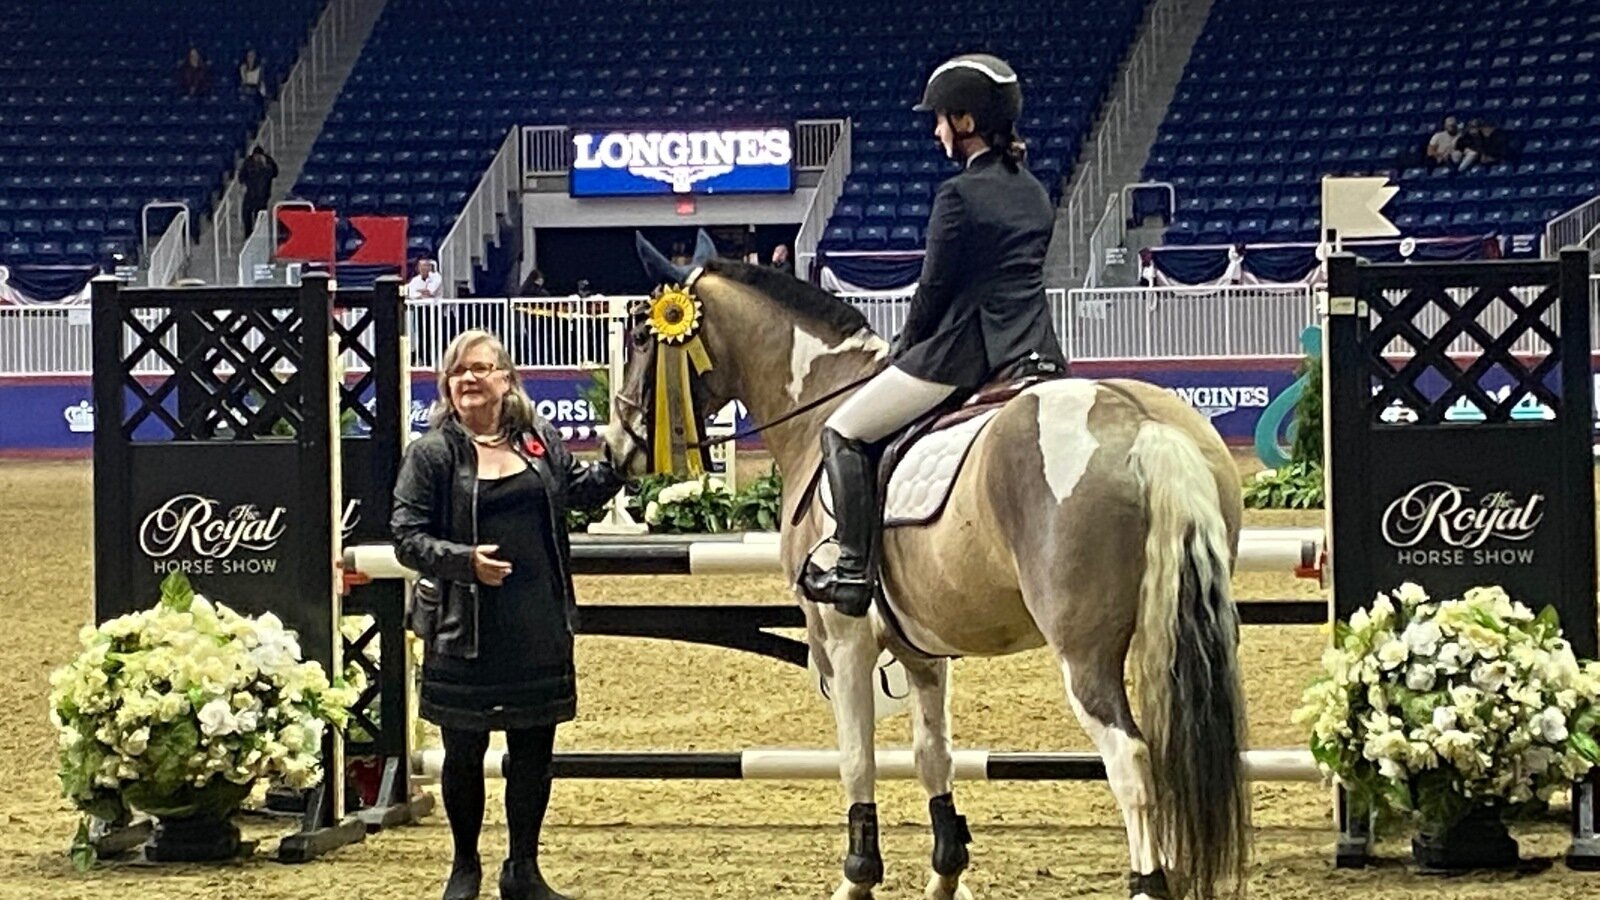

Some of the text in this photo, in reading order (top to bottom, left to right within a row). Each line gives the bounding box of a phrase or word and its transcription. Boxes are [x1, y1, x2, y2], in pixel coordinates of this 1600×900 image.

[573, 129, 792, 169] LONGINES
[1172, 386, 1270, 408] NGINES
[1480, 491, 1517, 508] The
[228, 504, 260, 520] The
[1381, 481, 1545, 548] Royal
[140, 494, 287, 558] Royal
[153, 559, 277, 574] HORSE SHOW
[1398, 551, 1534, 565] HORSE SHOW
